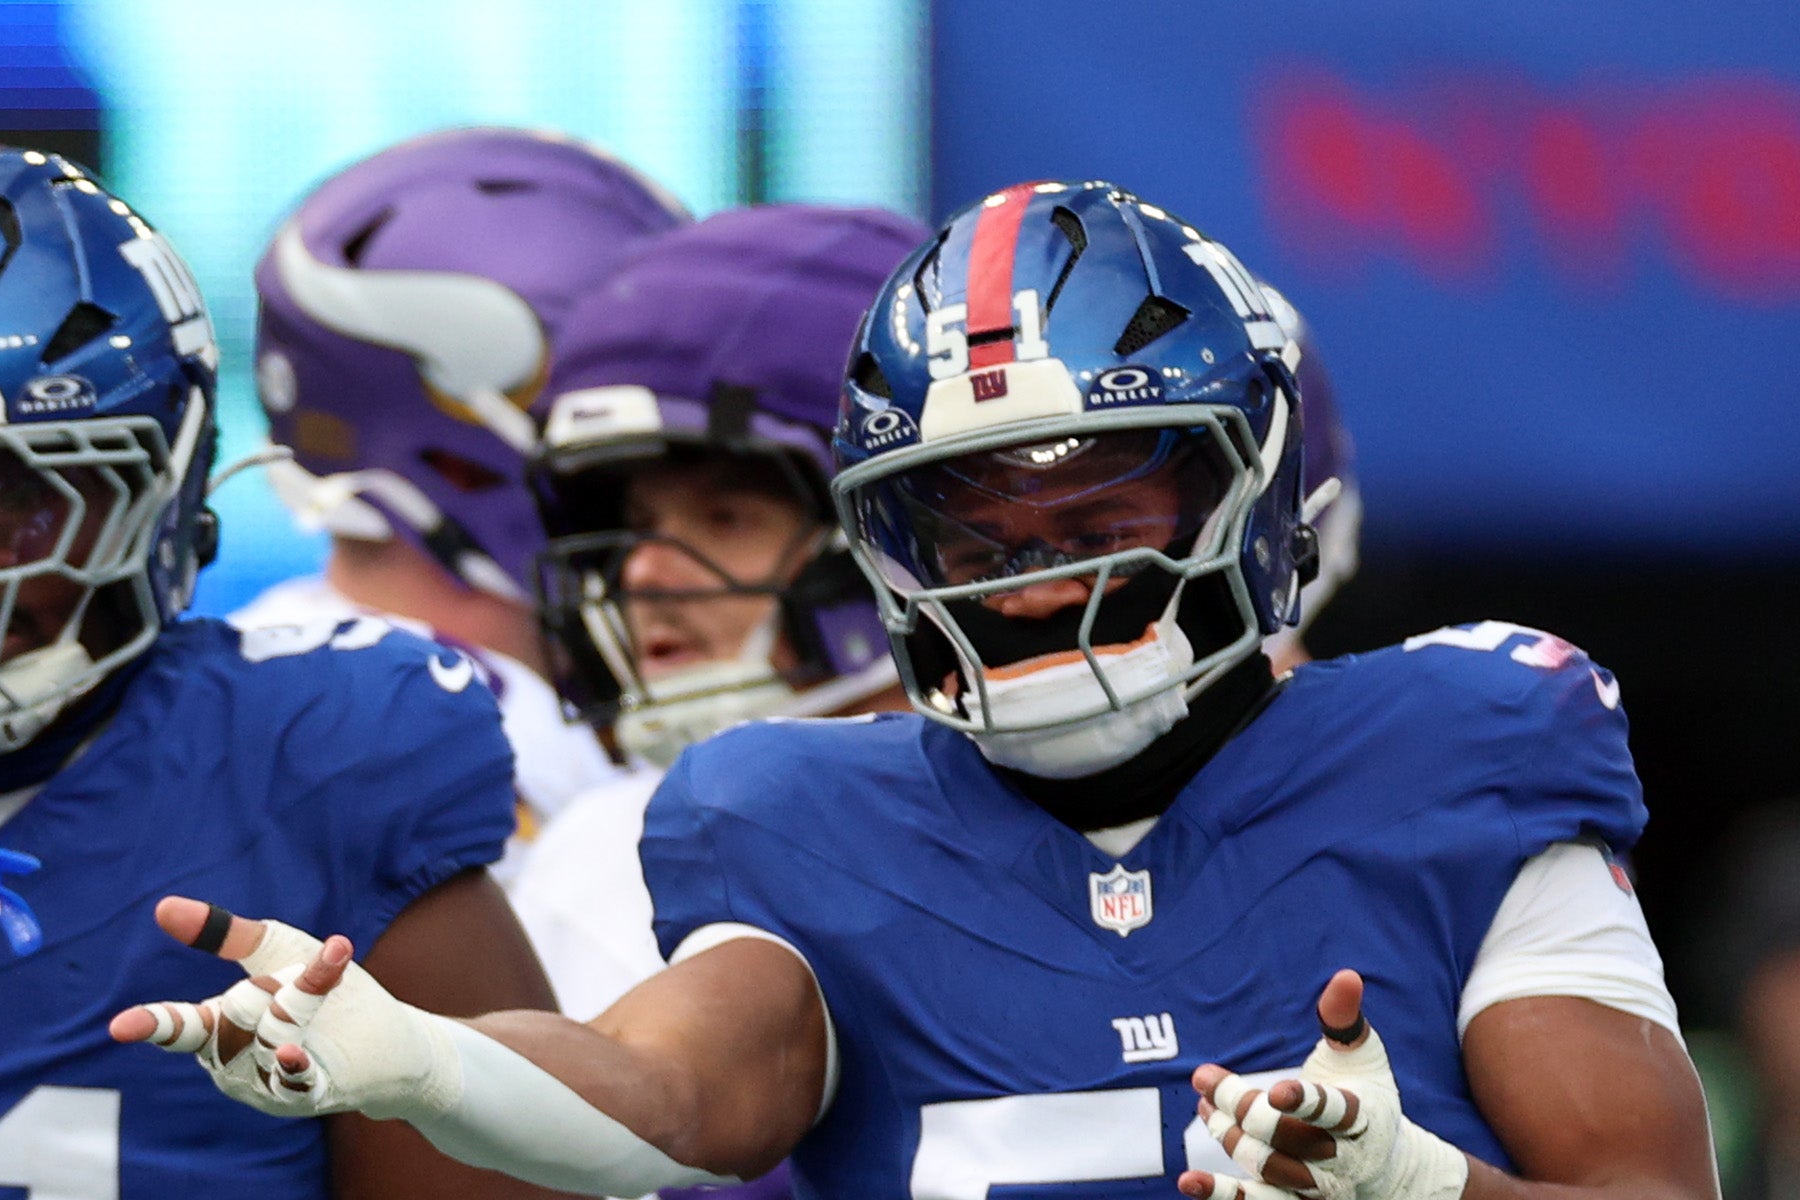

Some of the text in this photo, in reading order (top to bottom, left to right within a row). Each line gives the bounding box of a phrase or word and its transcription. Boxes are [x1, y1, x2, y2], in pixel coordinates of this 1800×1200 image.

[925, 289, 1049, 381] 51
[1089, 386, 1161, 405] OAKLEY
[864, 425, 912, 449] OAKLEY
[1102, 892, 1144, 921] NFL
